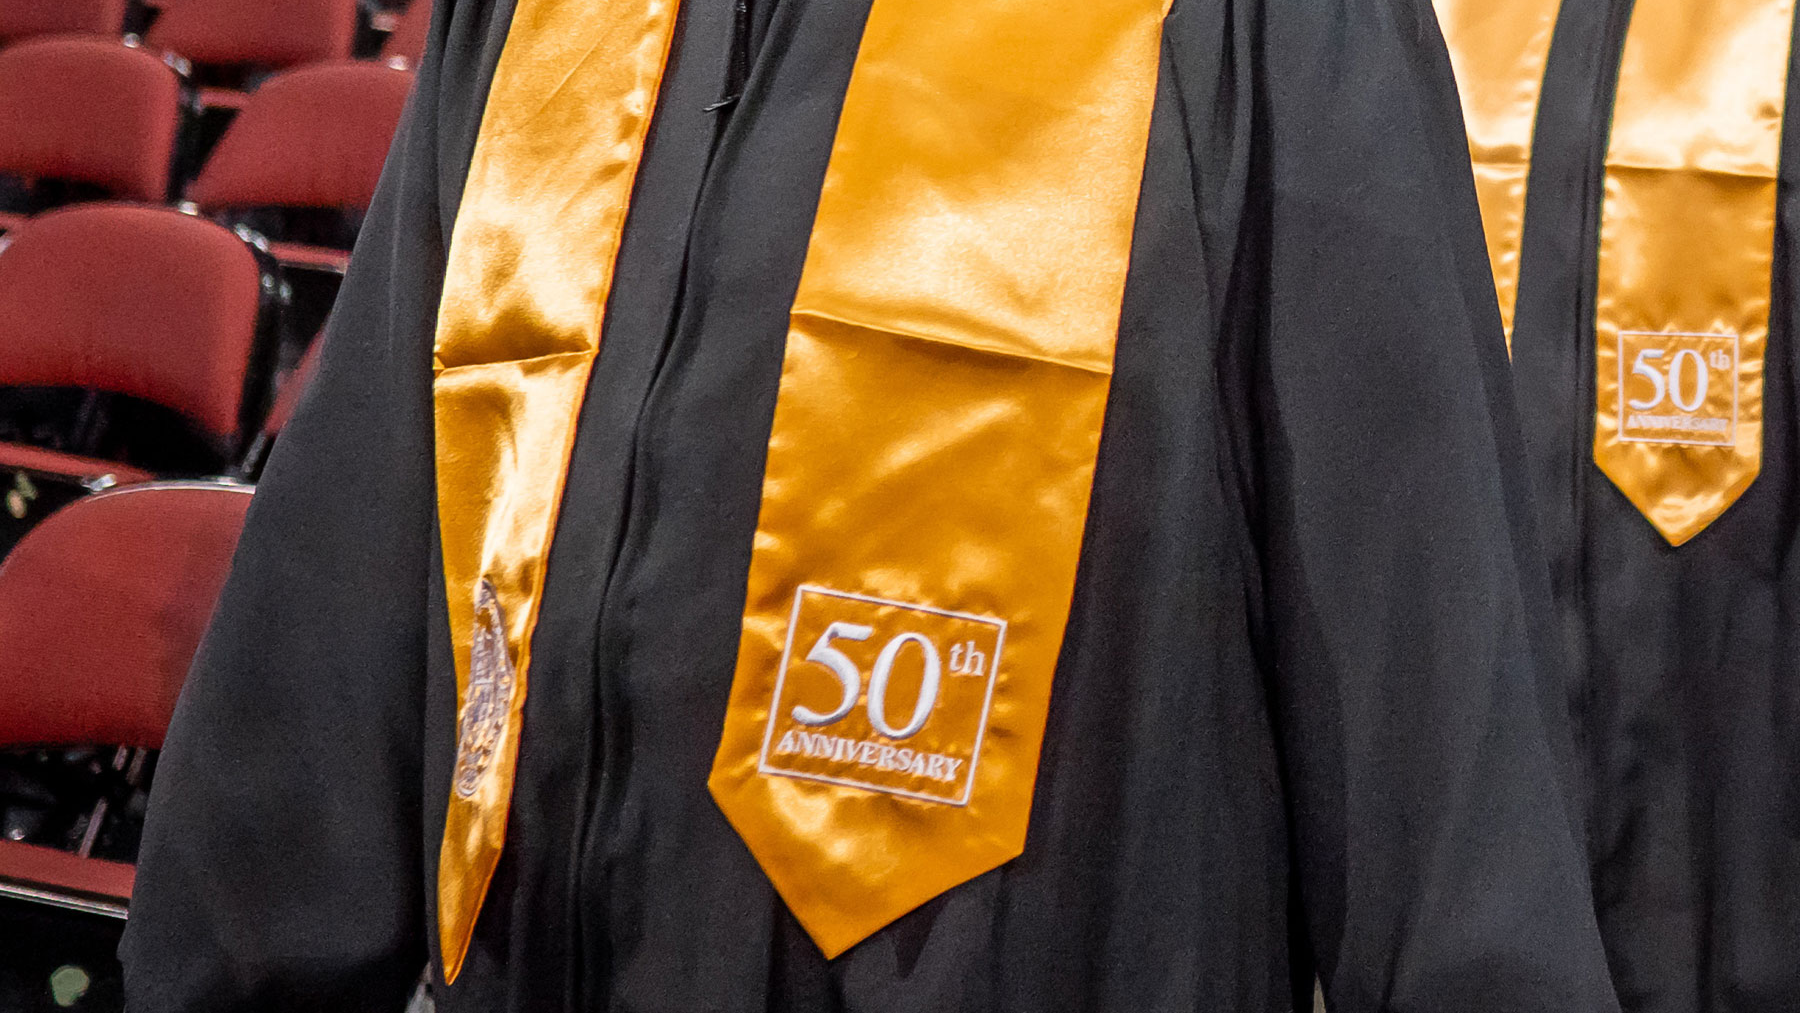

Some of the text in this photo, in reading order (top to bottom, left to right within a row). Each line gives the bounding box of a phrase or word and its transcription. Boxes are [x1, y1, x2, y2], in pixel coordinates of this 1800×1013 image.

[1628, 348, 1730, 412] 50th
[791, 621, 985, 739] 50th
[776, 731, 963, 782] ANNIVERSARY
